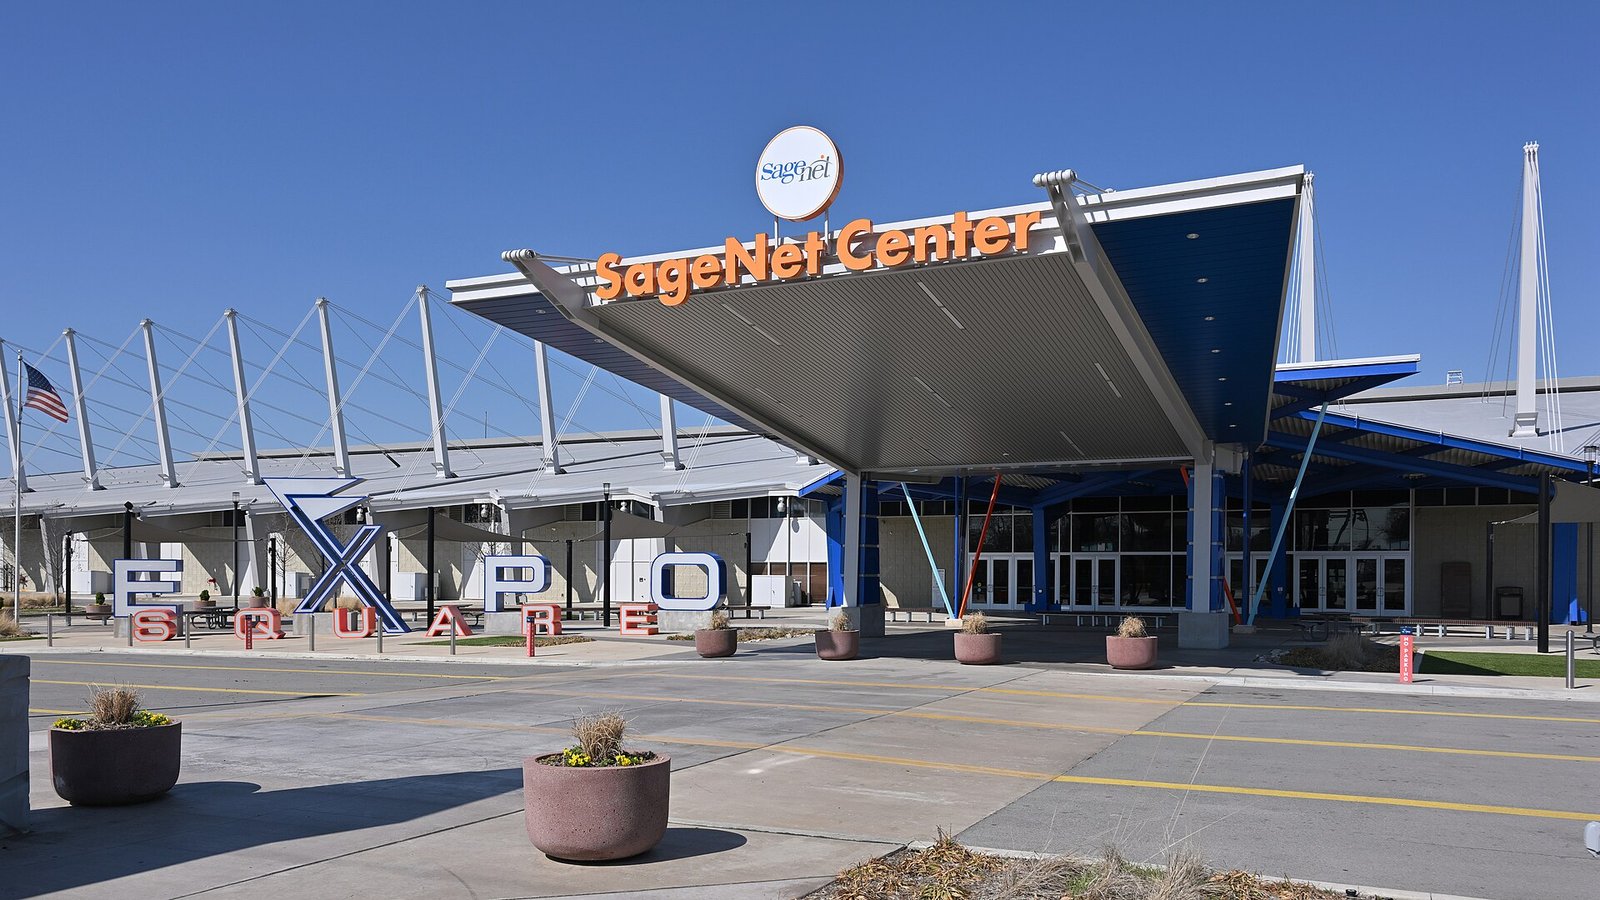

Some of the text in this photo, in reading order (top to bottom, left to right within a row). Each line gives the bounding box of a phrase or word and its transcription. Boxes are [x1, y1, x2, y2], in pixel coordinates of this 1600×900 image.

[595, 210, 1042, 307] SageNet Center
[113, 476, 727, 633] EXPO
[132, 602, 659, 642] SQUARE
[1403, 636, 1409, 647] NO
